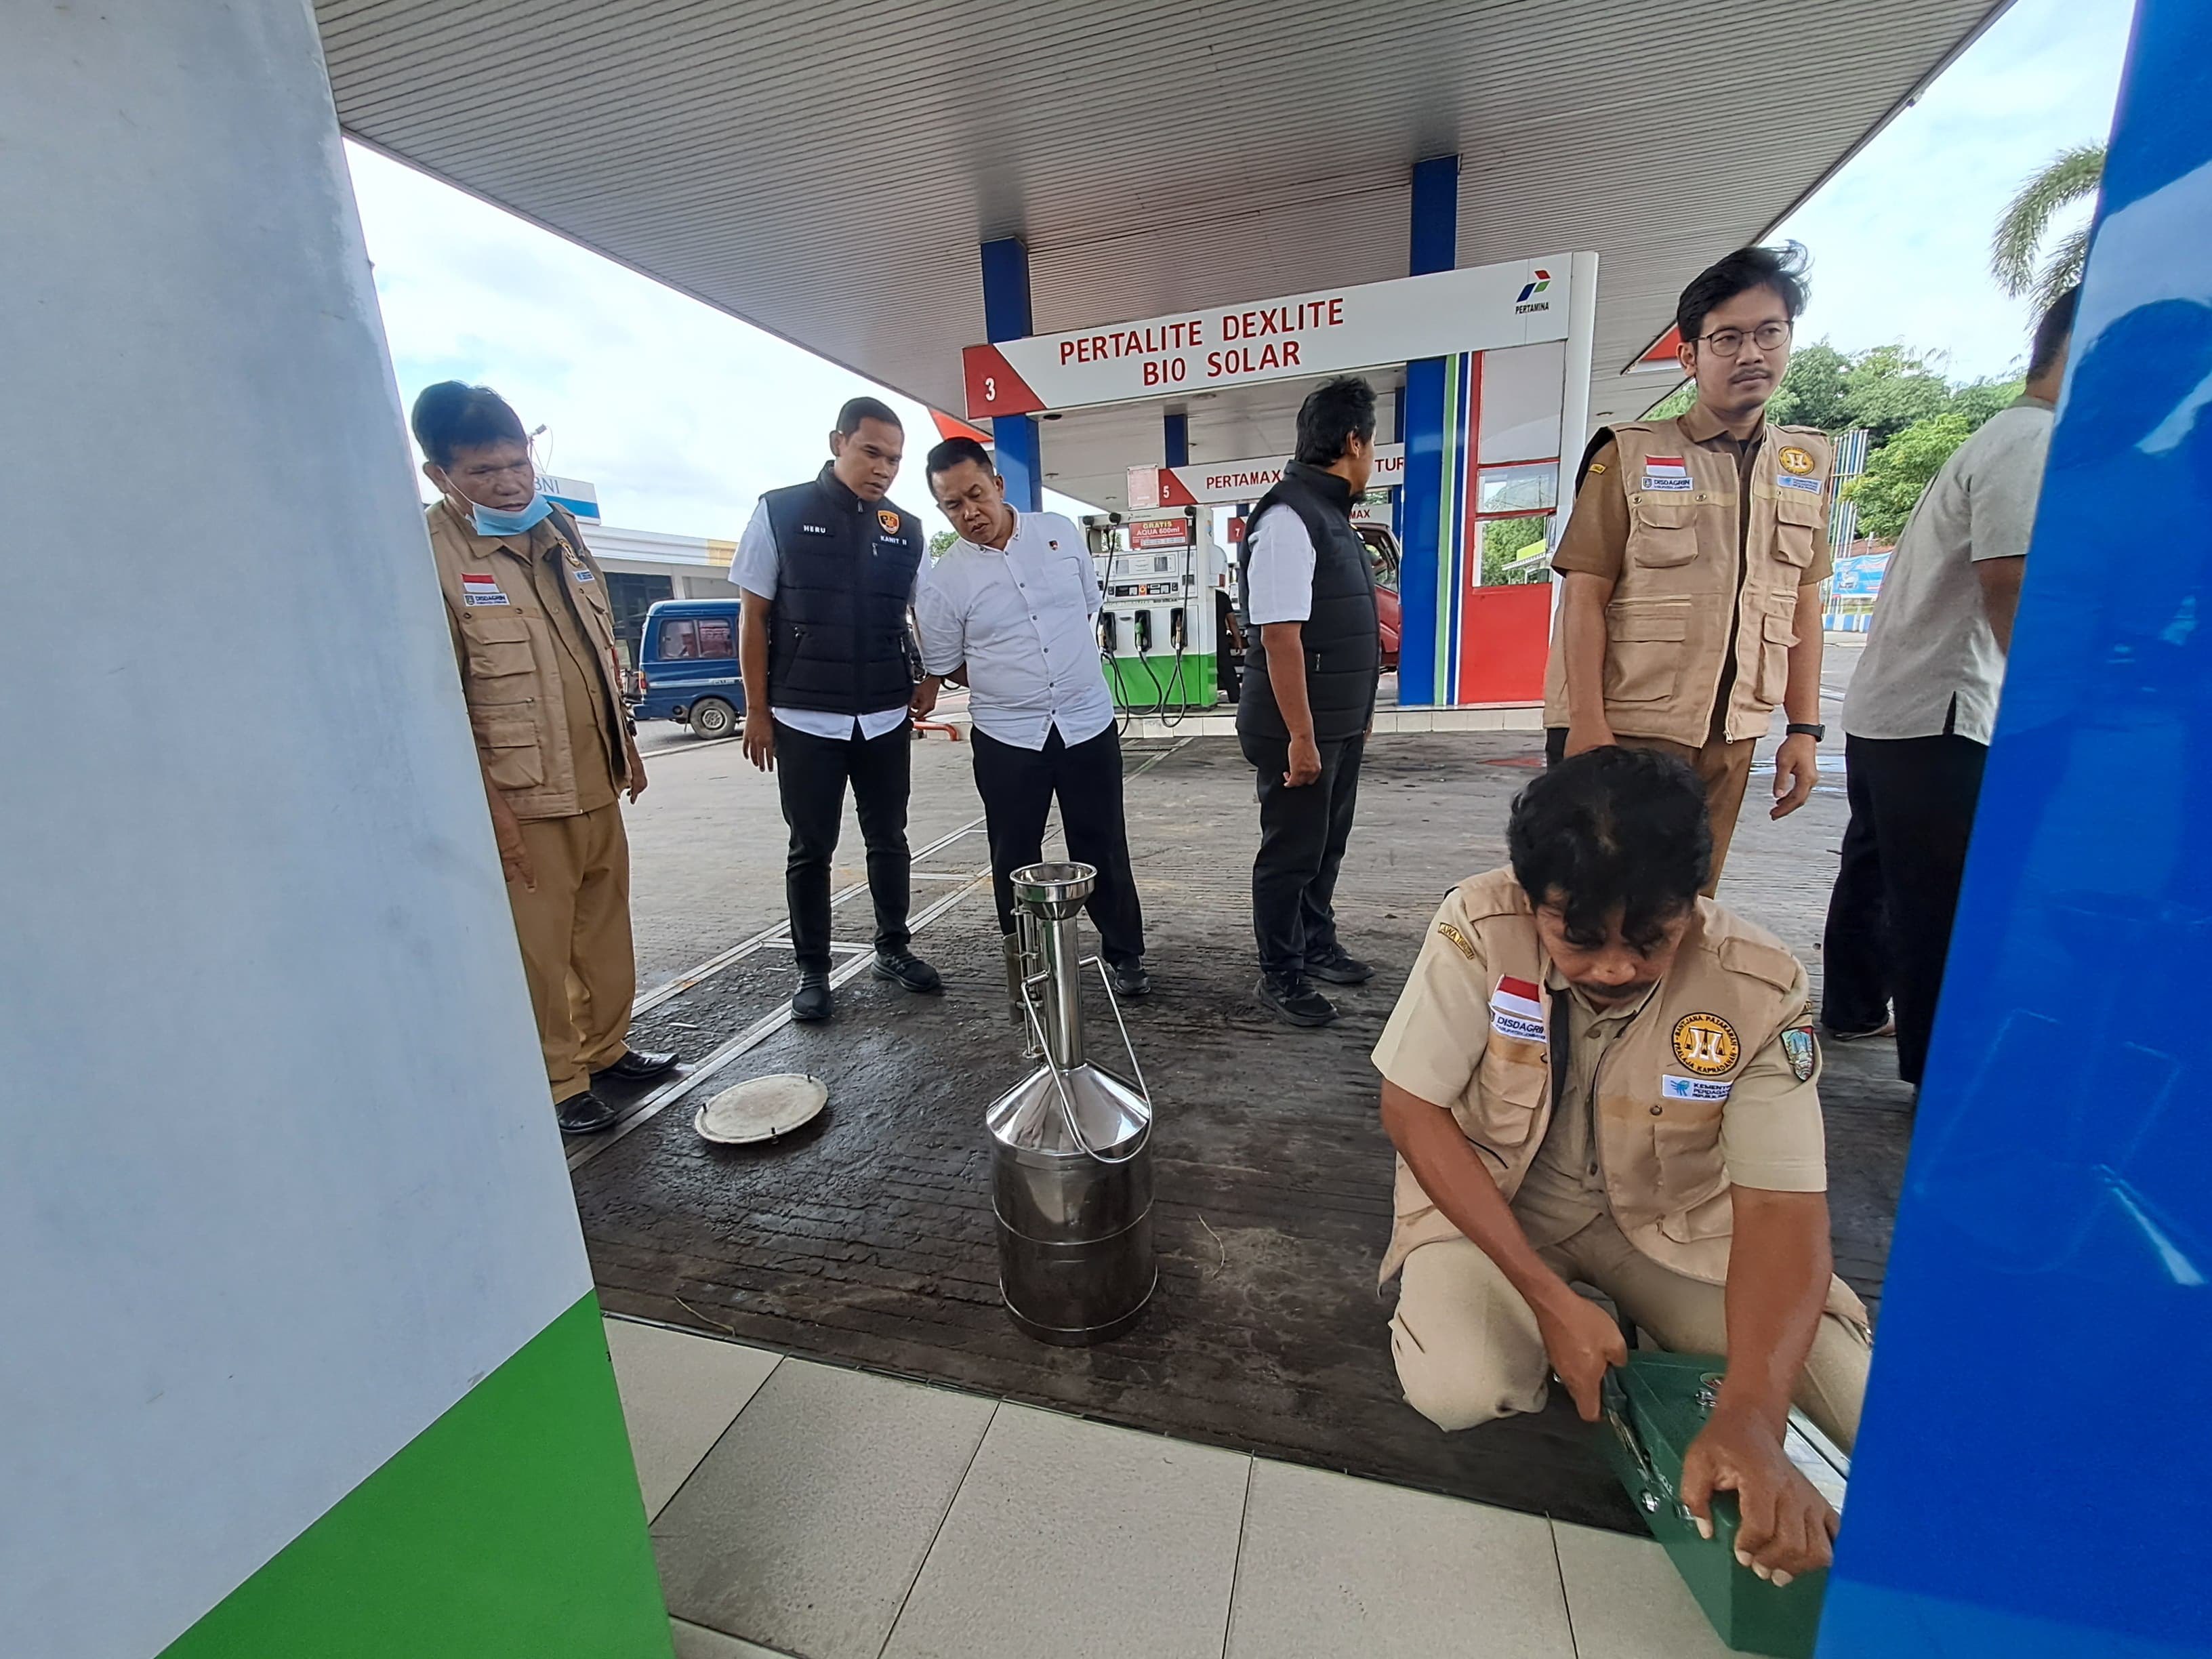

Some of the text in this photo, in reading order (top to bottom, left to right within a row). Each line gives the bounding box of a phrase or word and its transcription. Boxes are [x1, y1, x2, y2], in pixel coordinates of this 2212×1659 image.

[1515, 302, 1549, 314] PERTAMINA
[1059, 298, 1345, 367] PERTALITE DEXLITE
[1142, 340, 1301, 387] BIO SOLAR
[985, 377, 996, 402] 3
[1206, 469, 1283, 490] PERTAMAX
[1163, 485, 1170, 499] 5
[803, 525, 827, 534] HERU
[1142, 520, 1172, 529] GRATIS
[1158, 526, 1181, 535] 600ml
[1235, 527, 1241, 537] 7
[880, 535, 900, 544] KANIT
